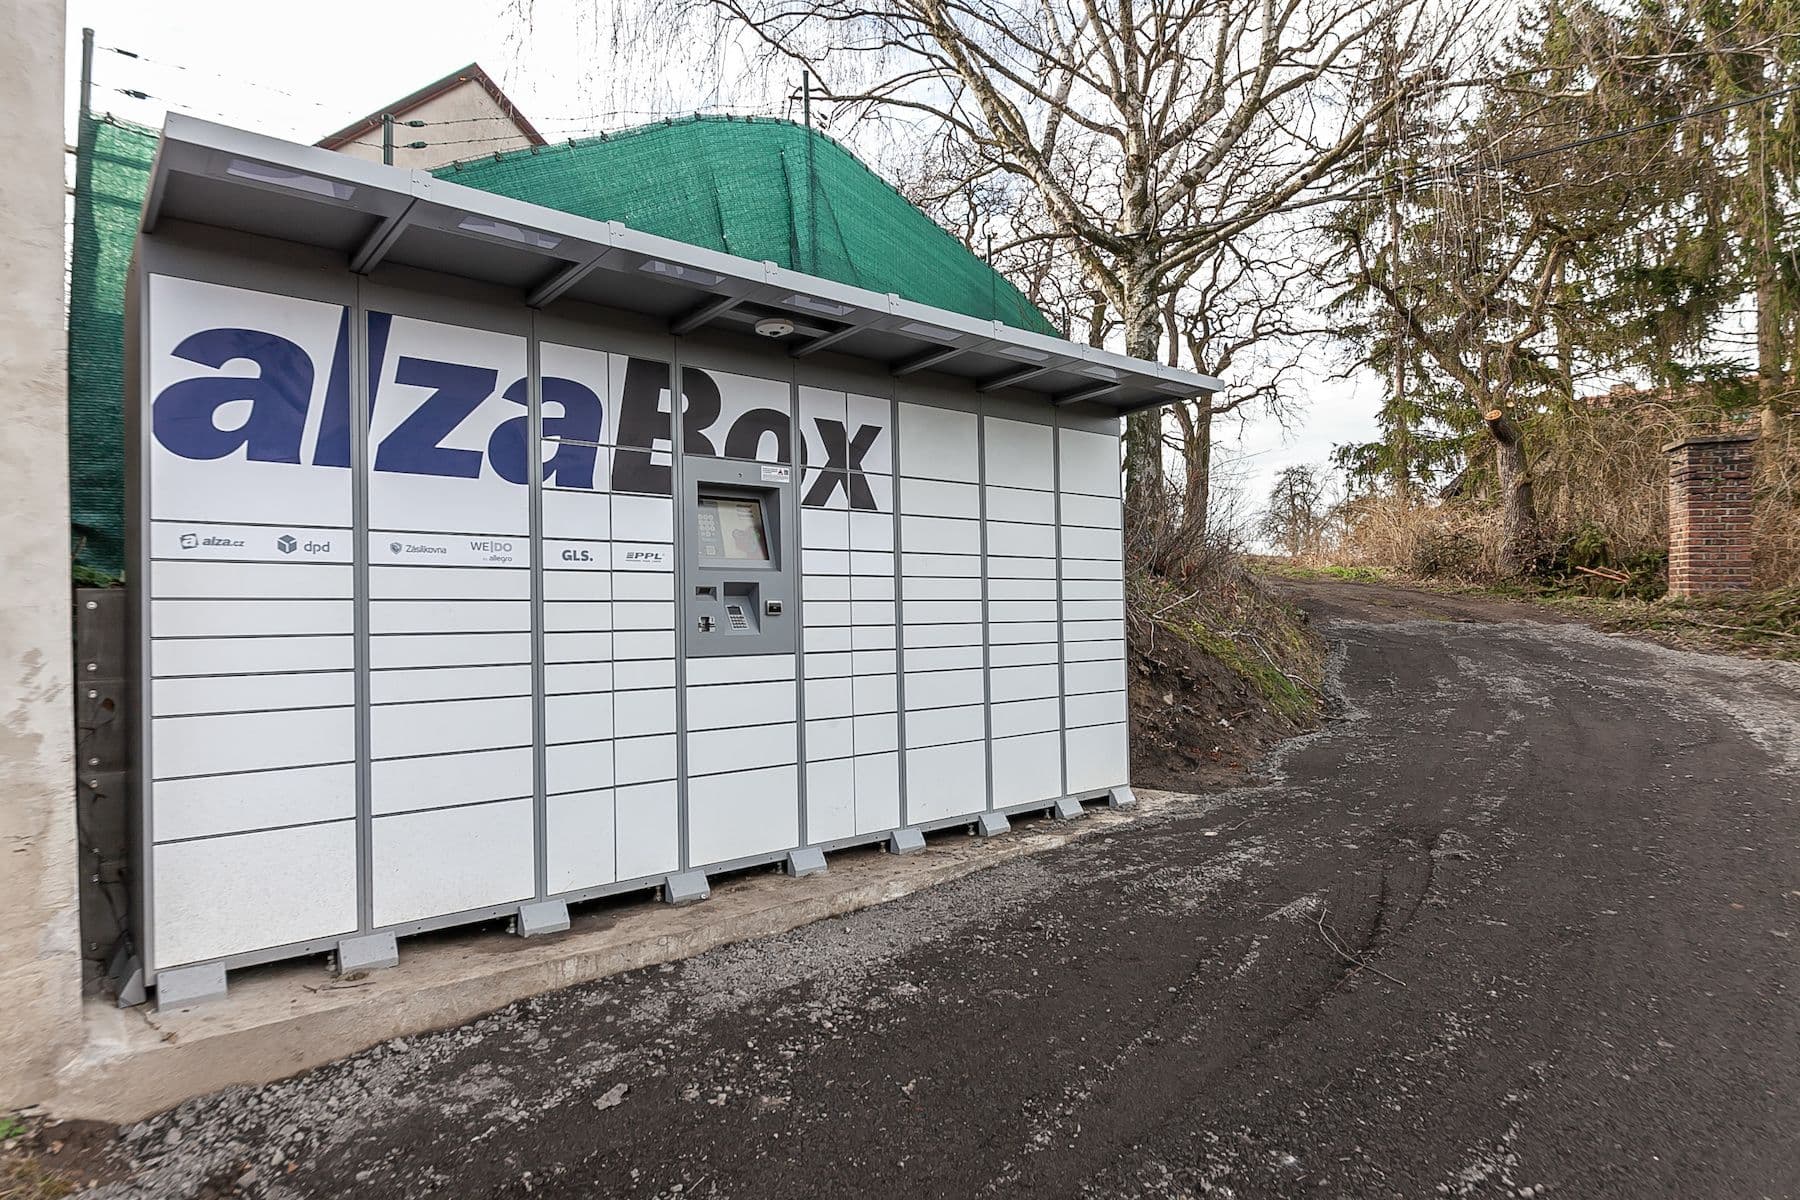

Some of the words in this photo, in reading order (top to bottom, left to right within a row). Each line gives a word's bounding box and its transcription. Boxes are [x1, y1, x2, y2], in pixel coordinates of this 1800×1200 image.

[152, 305, 883, 511] alzaBox
[202, 536, 246, 548] alza.cz
[303, 541, 331, 554] dpd
